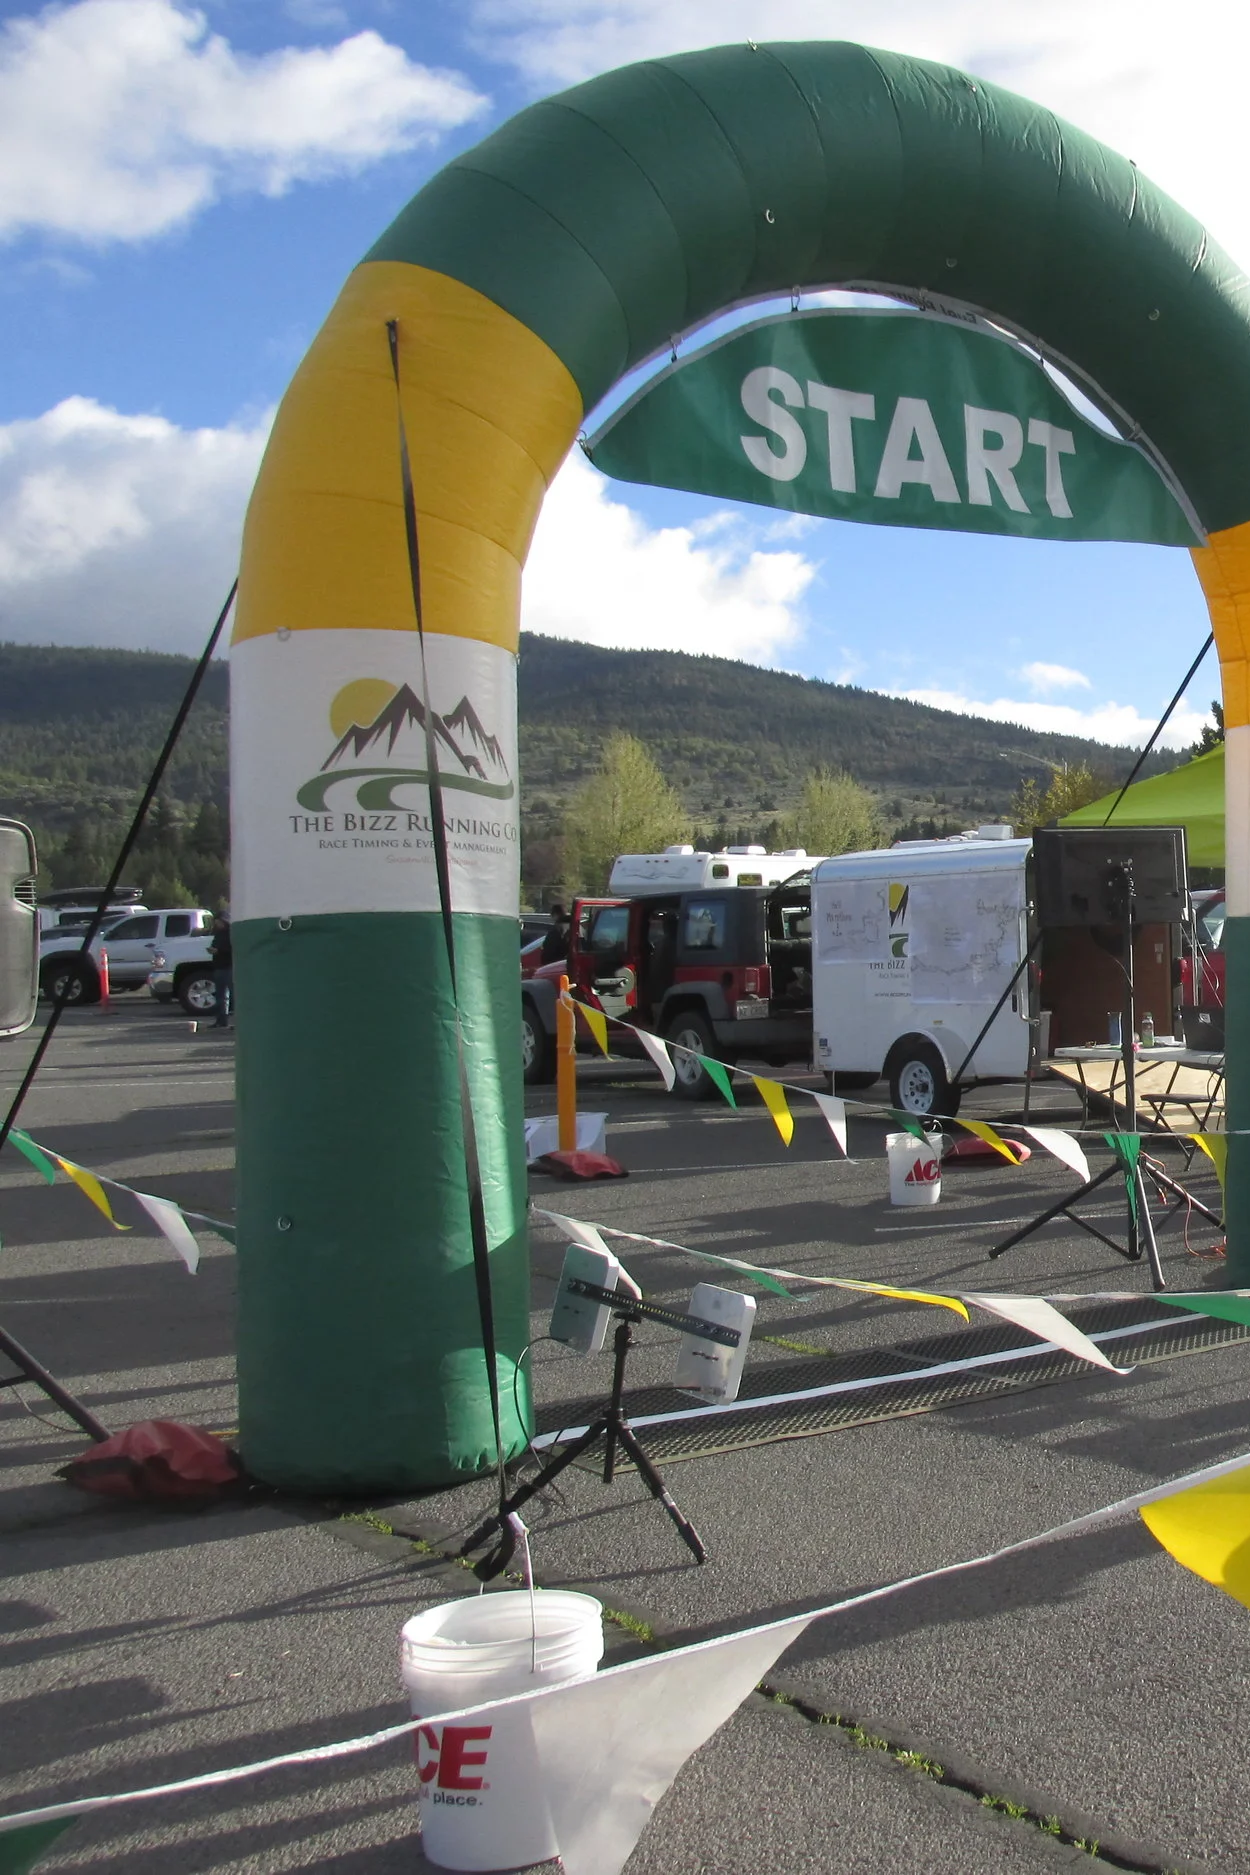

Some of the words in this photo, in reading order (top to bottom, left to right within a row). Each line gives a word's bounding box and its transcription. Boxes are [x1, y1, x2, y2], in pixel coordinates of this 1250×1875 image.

[740, 366, 1077, 519] START
[289, 815, 335, 834] THE
[343, 813, 398, 832] BIZZ
[319, 839, 348, 849] RACE
[352, 838, 399, 849] TIMING
[402, 839, 412, 848] &
[416, 839, 450, 849] EVET
[454, 842, 507, 856] MANAGEMENT
[433, 1791, 484, 1807] place.
